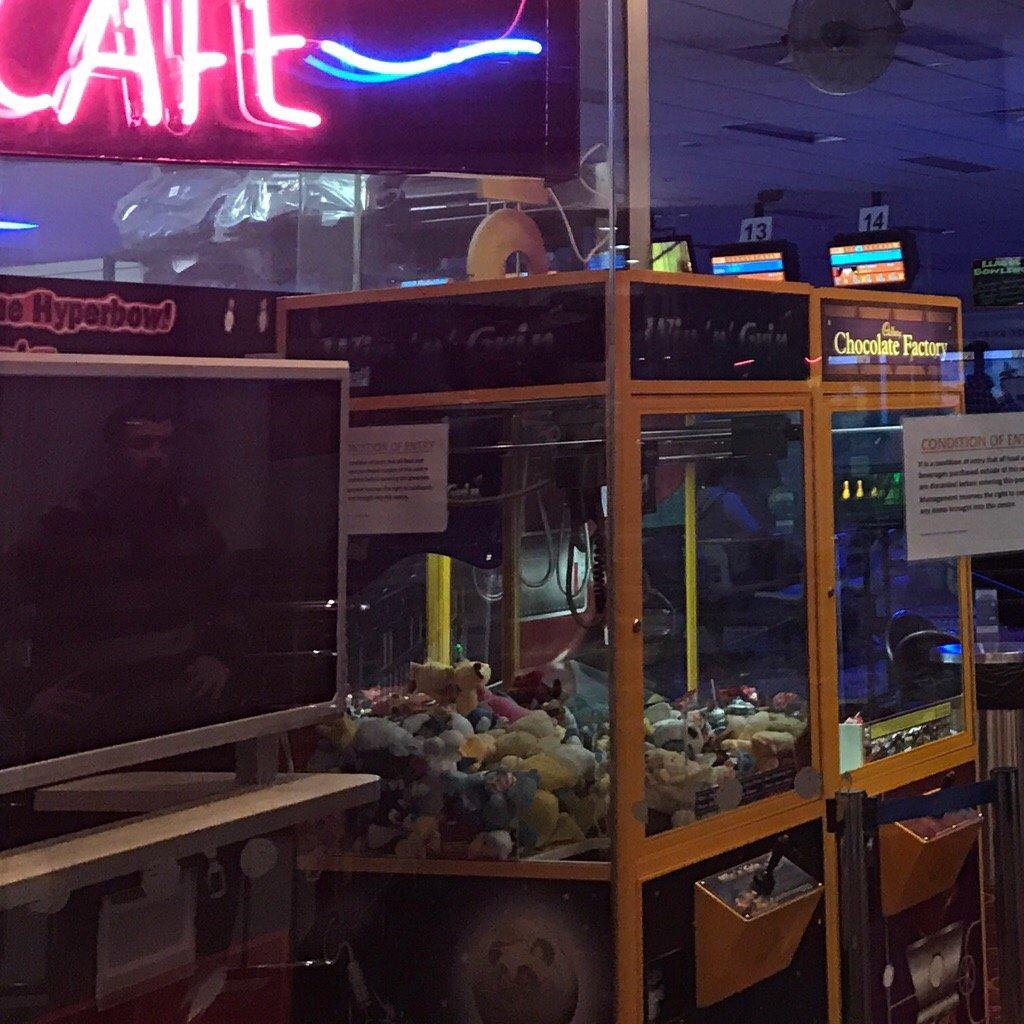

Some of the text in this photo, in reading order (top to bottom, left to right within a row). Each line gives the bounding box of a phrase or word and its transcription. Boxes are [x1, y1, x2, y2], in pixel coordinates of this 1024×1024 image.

[865, 212, 885, 232] 14
[745, 223, 767, 240] 13
[835, 331, 948, 361] Chocolate Factory
[921, 436, 986, 450] CONDITION
[989, 435, 1004, 447] OF
